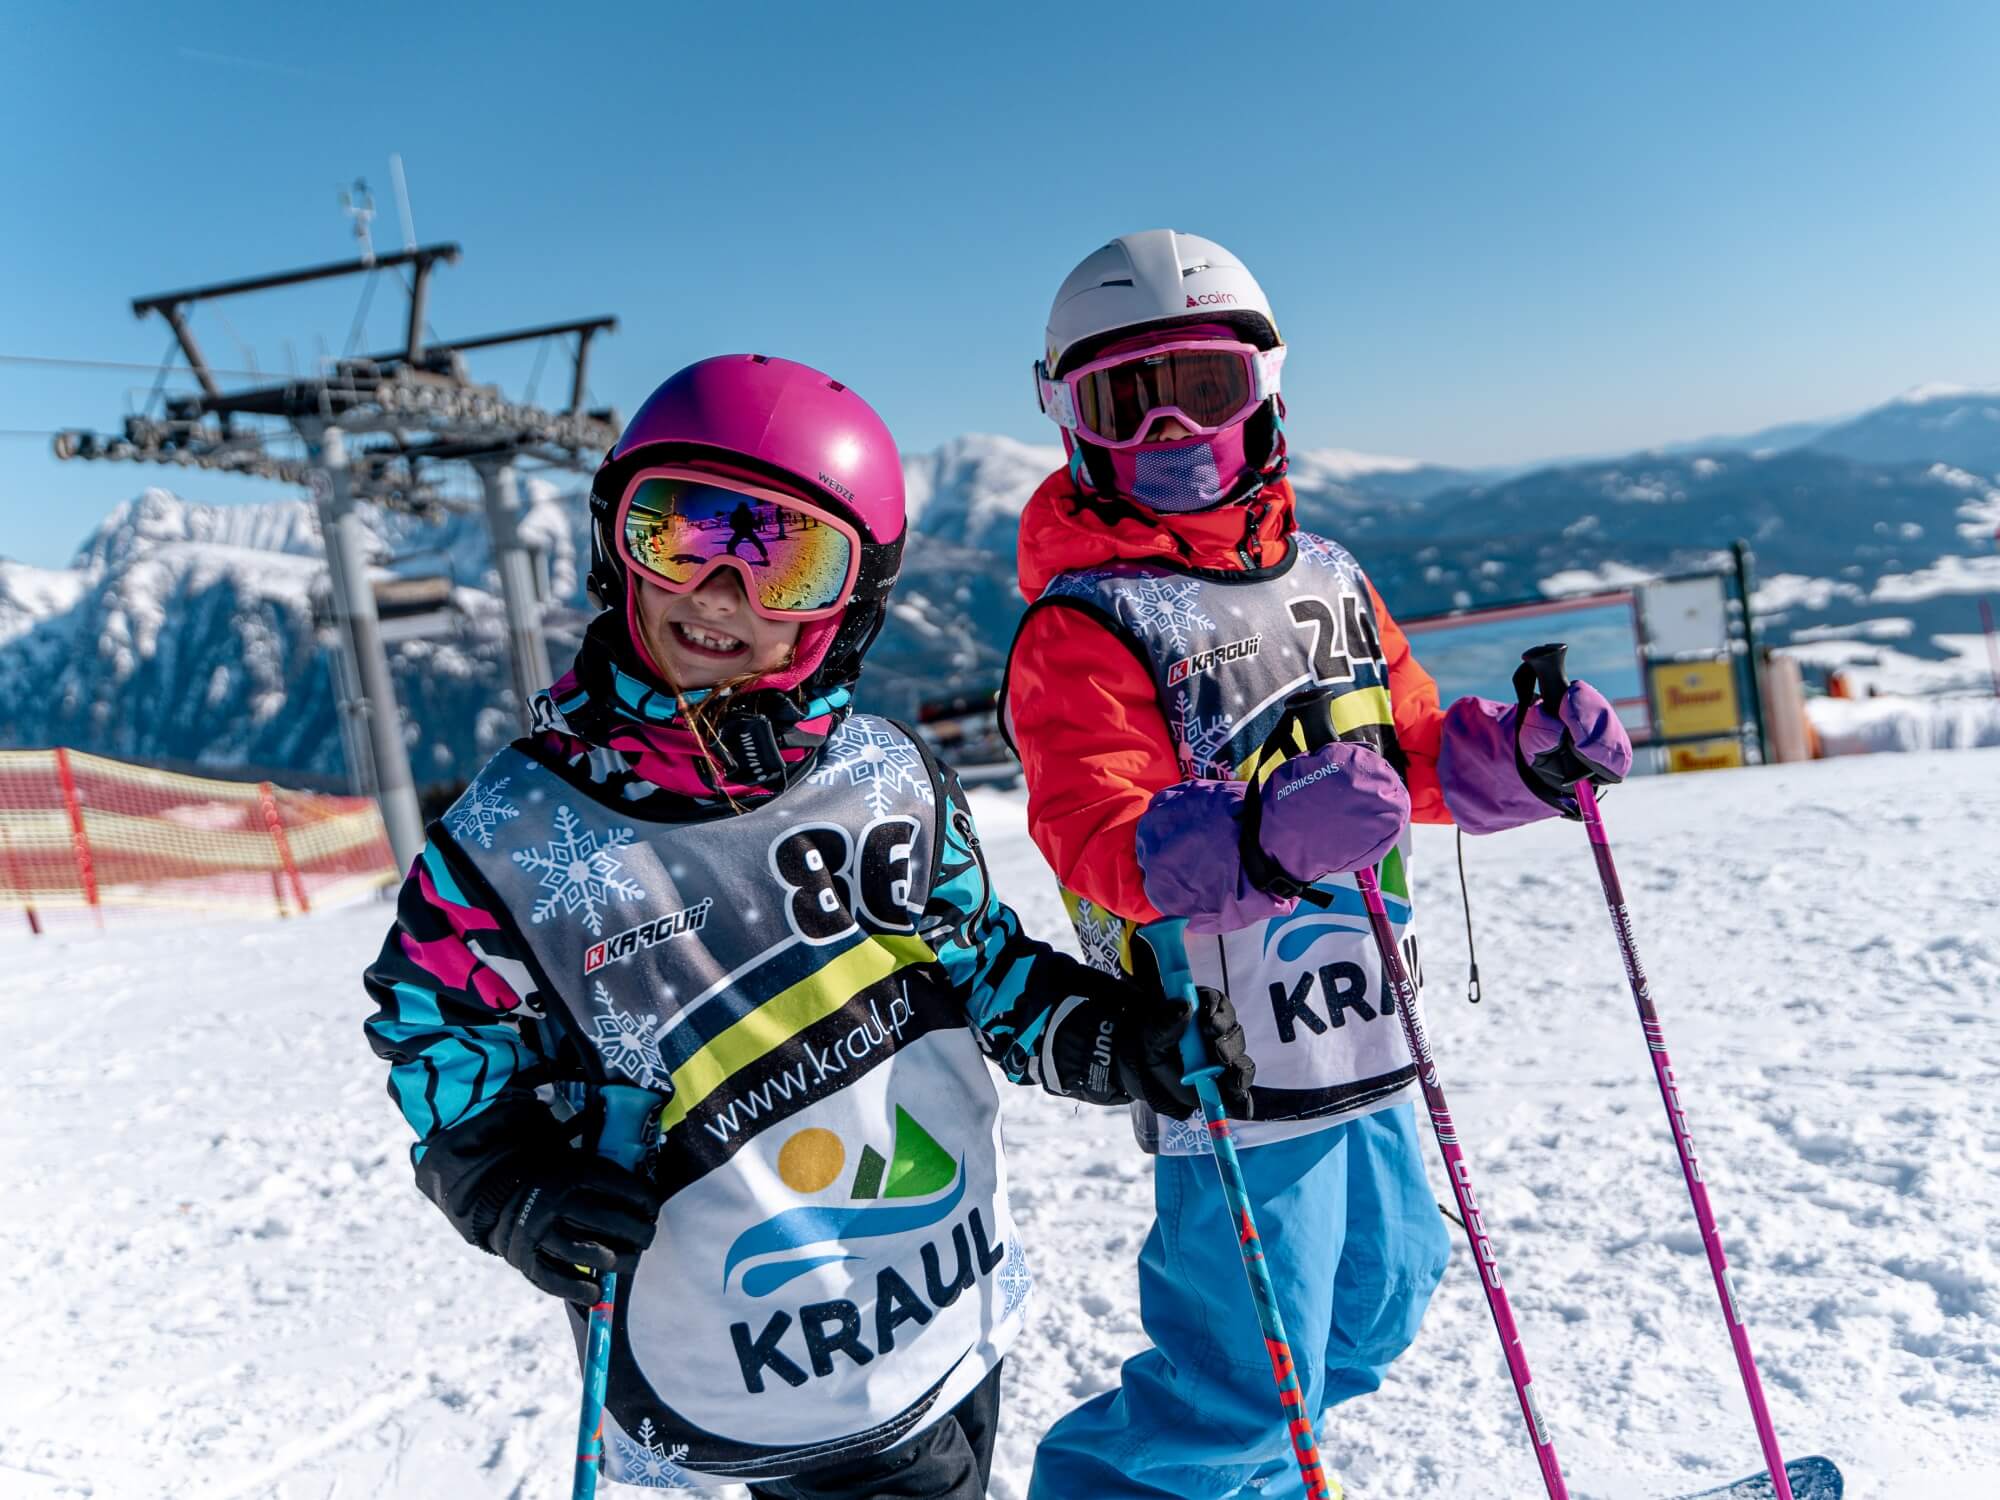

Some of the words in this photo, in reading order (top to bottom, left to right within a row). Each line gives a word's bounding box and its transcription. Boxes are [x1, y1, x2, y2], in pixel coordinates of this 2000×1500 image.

[1198, 291, 1238, 305] cairn
[818, 471, 855, 503] WEDZE
[1277, 762, 1340, 800] DIDRIKSONS
[768, 815, 920, 946] 86
[704, 979, 915, 1143] www.kraul.pl
[729, 1206, 1004, 1393] KRAUL
